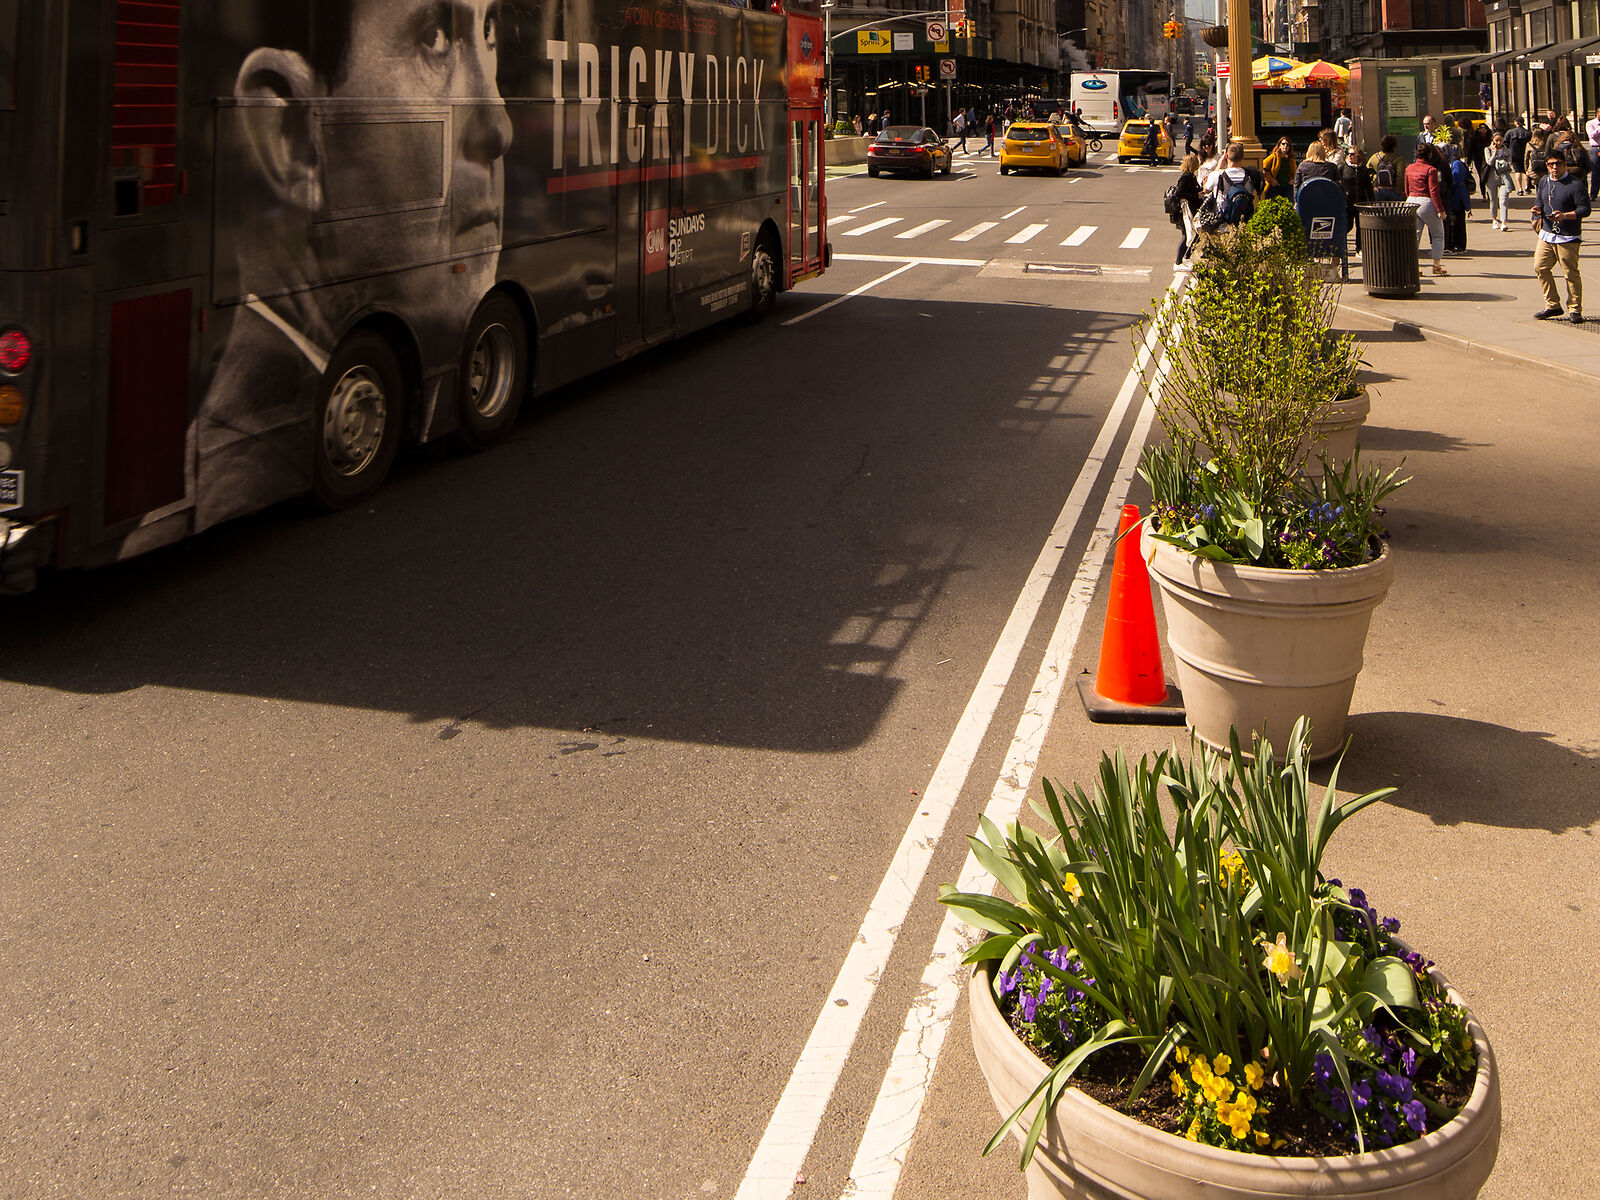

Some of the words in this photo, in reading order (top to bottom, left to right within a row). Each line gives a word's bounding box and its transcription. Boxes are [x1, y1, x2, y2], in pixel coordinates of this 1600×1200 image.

[624, 7, 632, 24] A
[633, 7, 653, 25] CNN
[654, 10, 692, 32] ORIGINAL
[692, 16, 718, 35] SERIES
[546, 39, 695, 170] TRICKY
[706, 53, 766, 156] DICK
[669, 212, 705, 238] SUNDAYS
